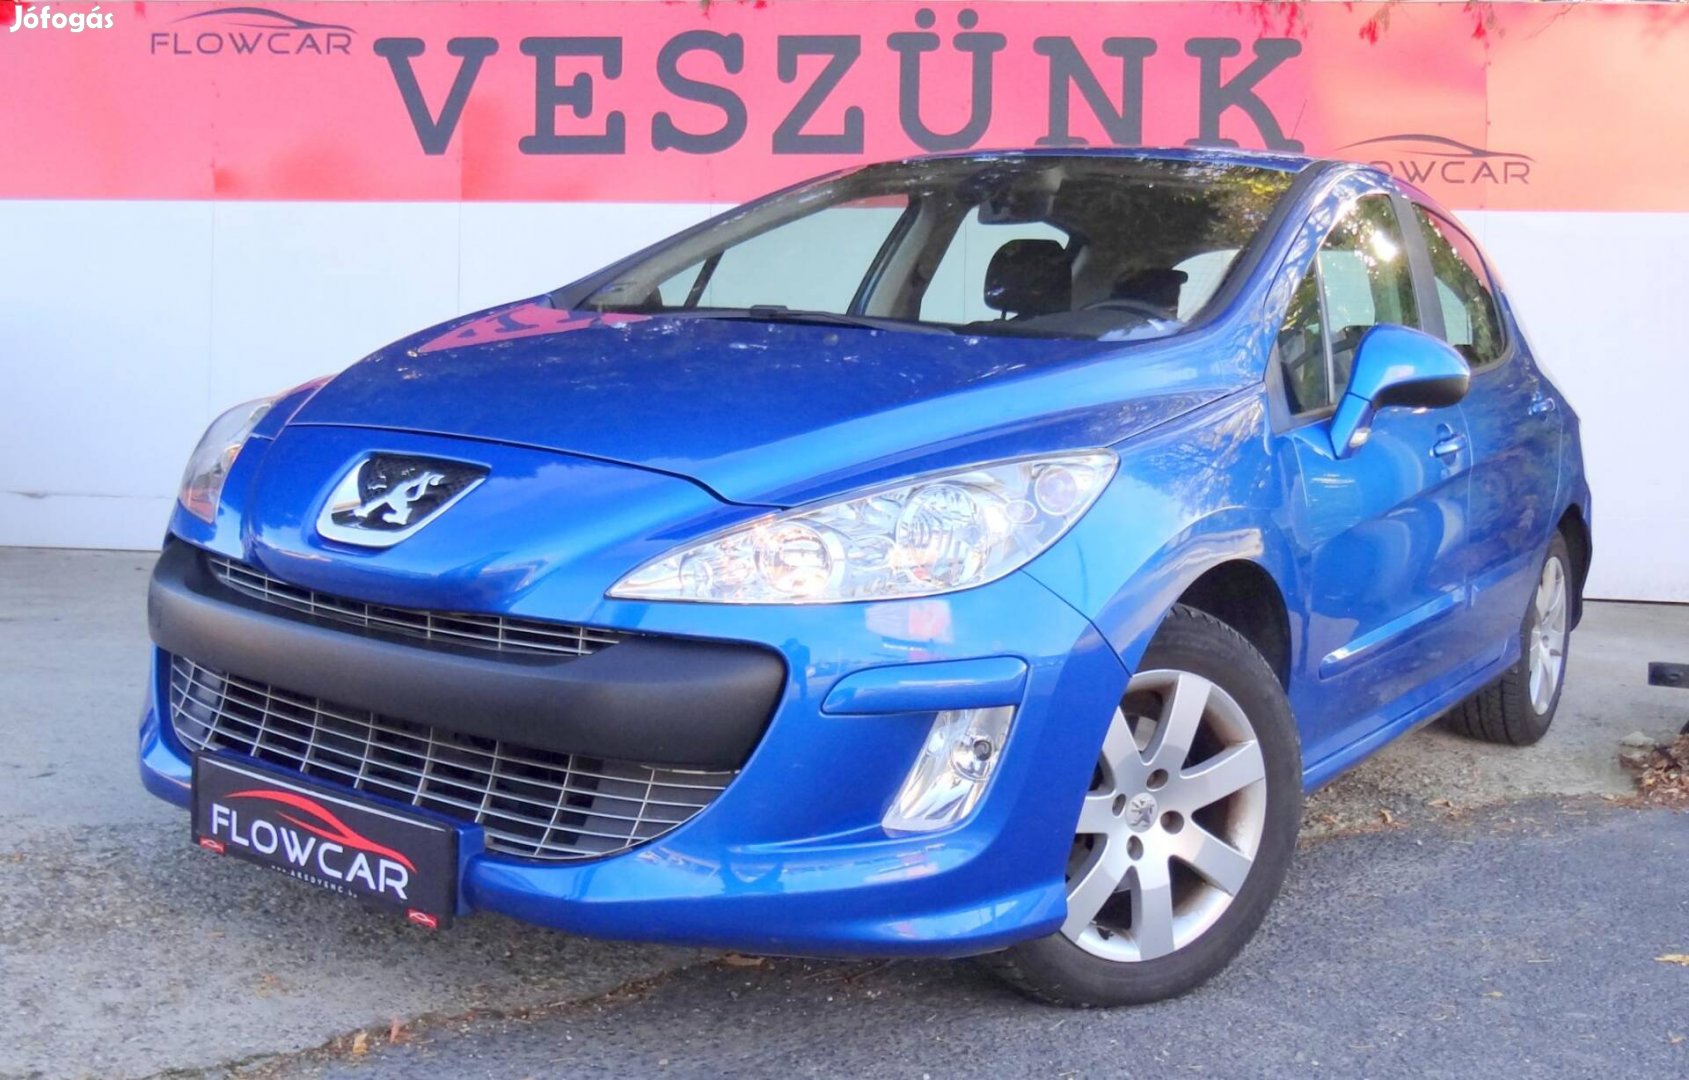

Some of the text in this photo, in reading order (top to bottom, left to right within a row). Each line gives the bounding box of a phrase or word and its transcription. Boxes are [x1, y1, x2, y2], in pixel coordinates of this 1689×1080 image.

[151, 32, 352, 55] FLOWCAR
[373, 8, 1304, 155] VESZÜNK
[1368, 160, 1531, 185] WCAR
[211, 802, 409, 900] FLOWCAR
